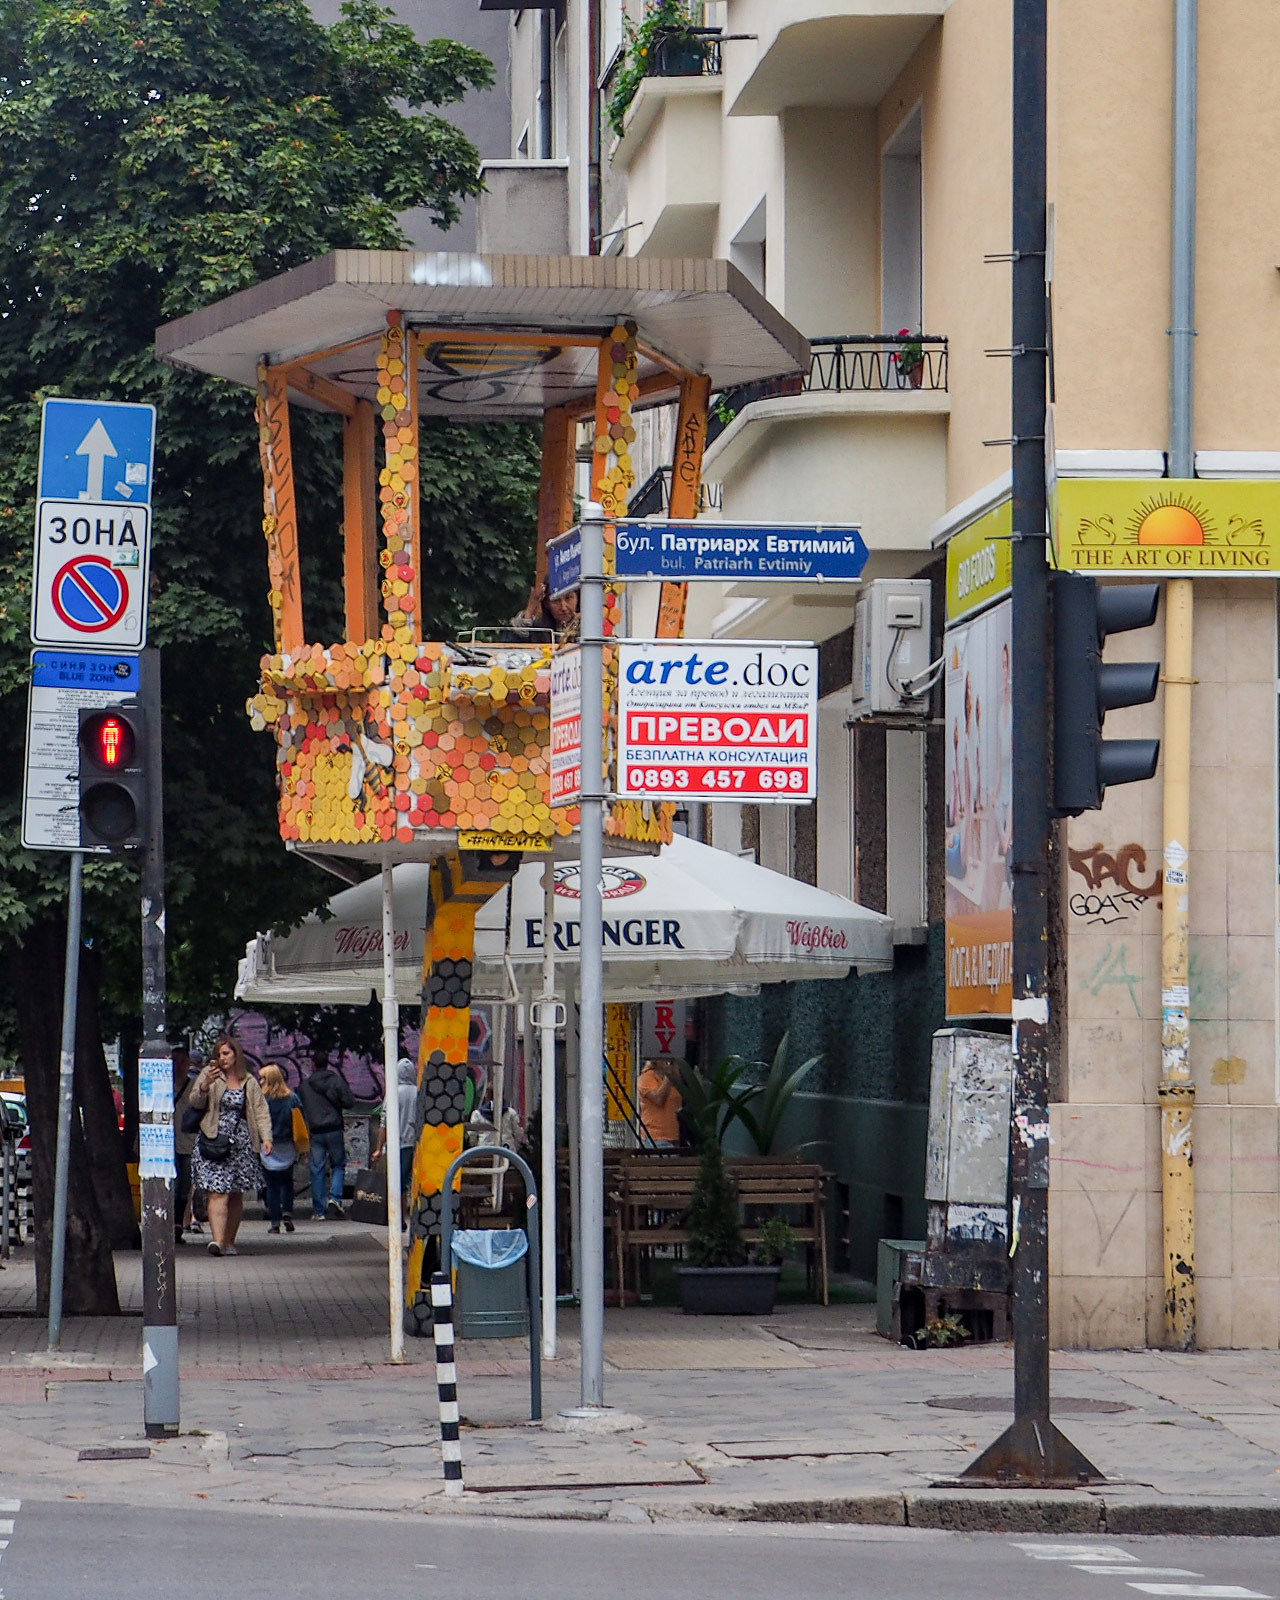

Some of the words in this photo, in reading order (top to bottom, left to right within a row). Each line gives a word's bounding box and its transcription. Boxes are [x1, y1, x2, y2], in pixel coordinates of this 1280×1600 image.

[49, 517, 138, 546] ЗОНА
[616, 531, 654, 554] бул.
[660, 533, 759, 555] Патриарх
[765, 536, 855, 554] Евтимий
[661, 556, 686, 569] bul.
[694, 557, 753, 571] Patriarh
[758, 558, 812, 574] Evtimiy
[971, 542, 996, 591] FOODS
[1072, 550, 1112, 565] THE
[1120, 550, 1161, 565] ART
[1165, 550, 1192, 565] OF
[1198, 550, 1270, 566] LIVING
[59, 670, 85, 681] BLUE
[89, 673, 115, 683] ZONE
[90, 662, 116, 673] ЗОН
[626, 653, 810, 686] arte.doc
[630, 716, 805, 744] ПРЕВОДИ
[626, 750, 704, 761] БЕЗПЛАТНА
[709, 751, 808, 765] КОНСУЛТАЦИЯ
[630, 769, 690, 788] 0893
[701, 770, 747, 788] 457
[758, 770, 804, 790] 698
[525, 918, 684, 951] ERDNGER
[655, 1000, 677, 1054] RY
